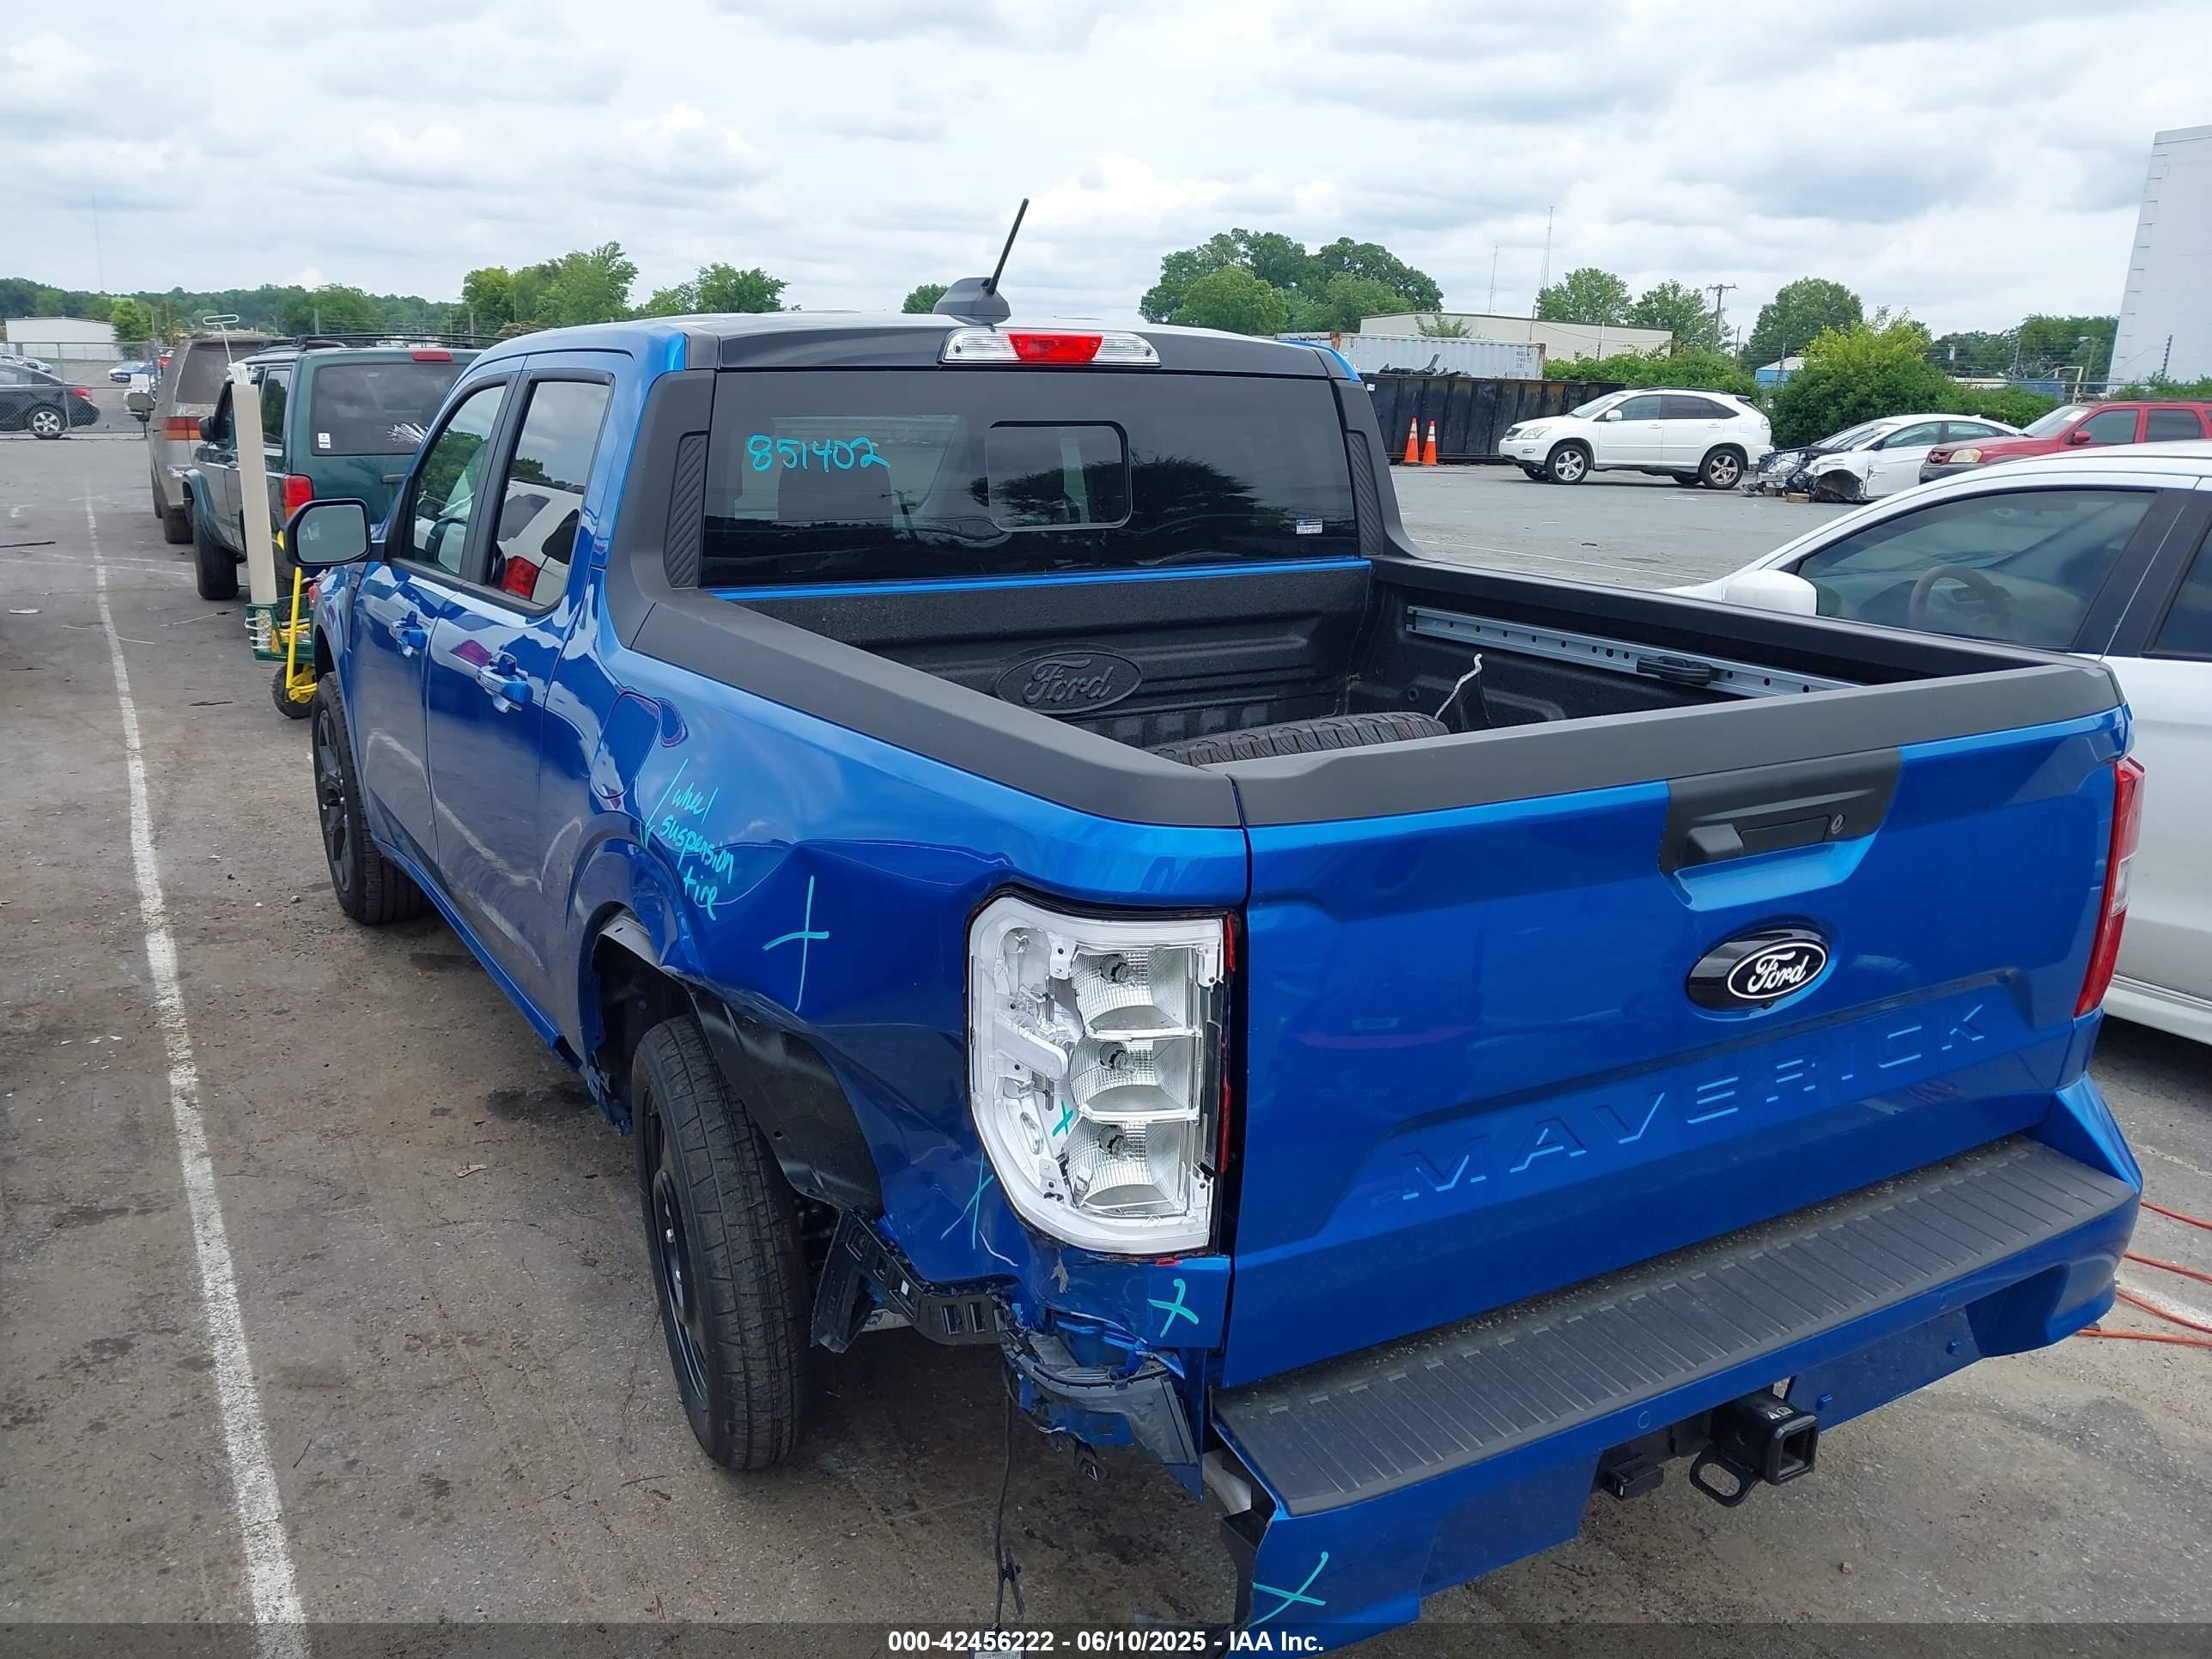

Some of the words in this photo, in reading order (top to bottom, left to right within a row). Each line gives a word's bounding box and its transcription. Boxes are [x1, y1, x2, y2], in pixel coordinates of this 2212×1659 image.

[747, 434, 891, 473] 851402
[1023, 658, 1115, 705] Ford
[1747, 951, 1809, 993] Ford
[1401, 1004, 1985, 1200] MAVERICK
